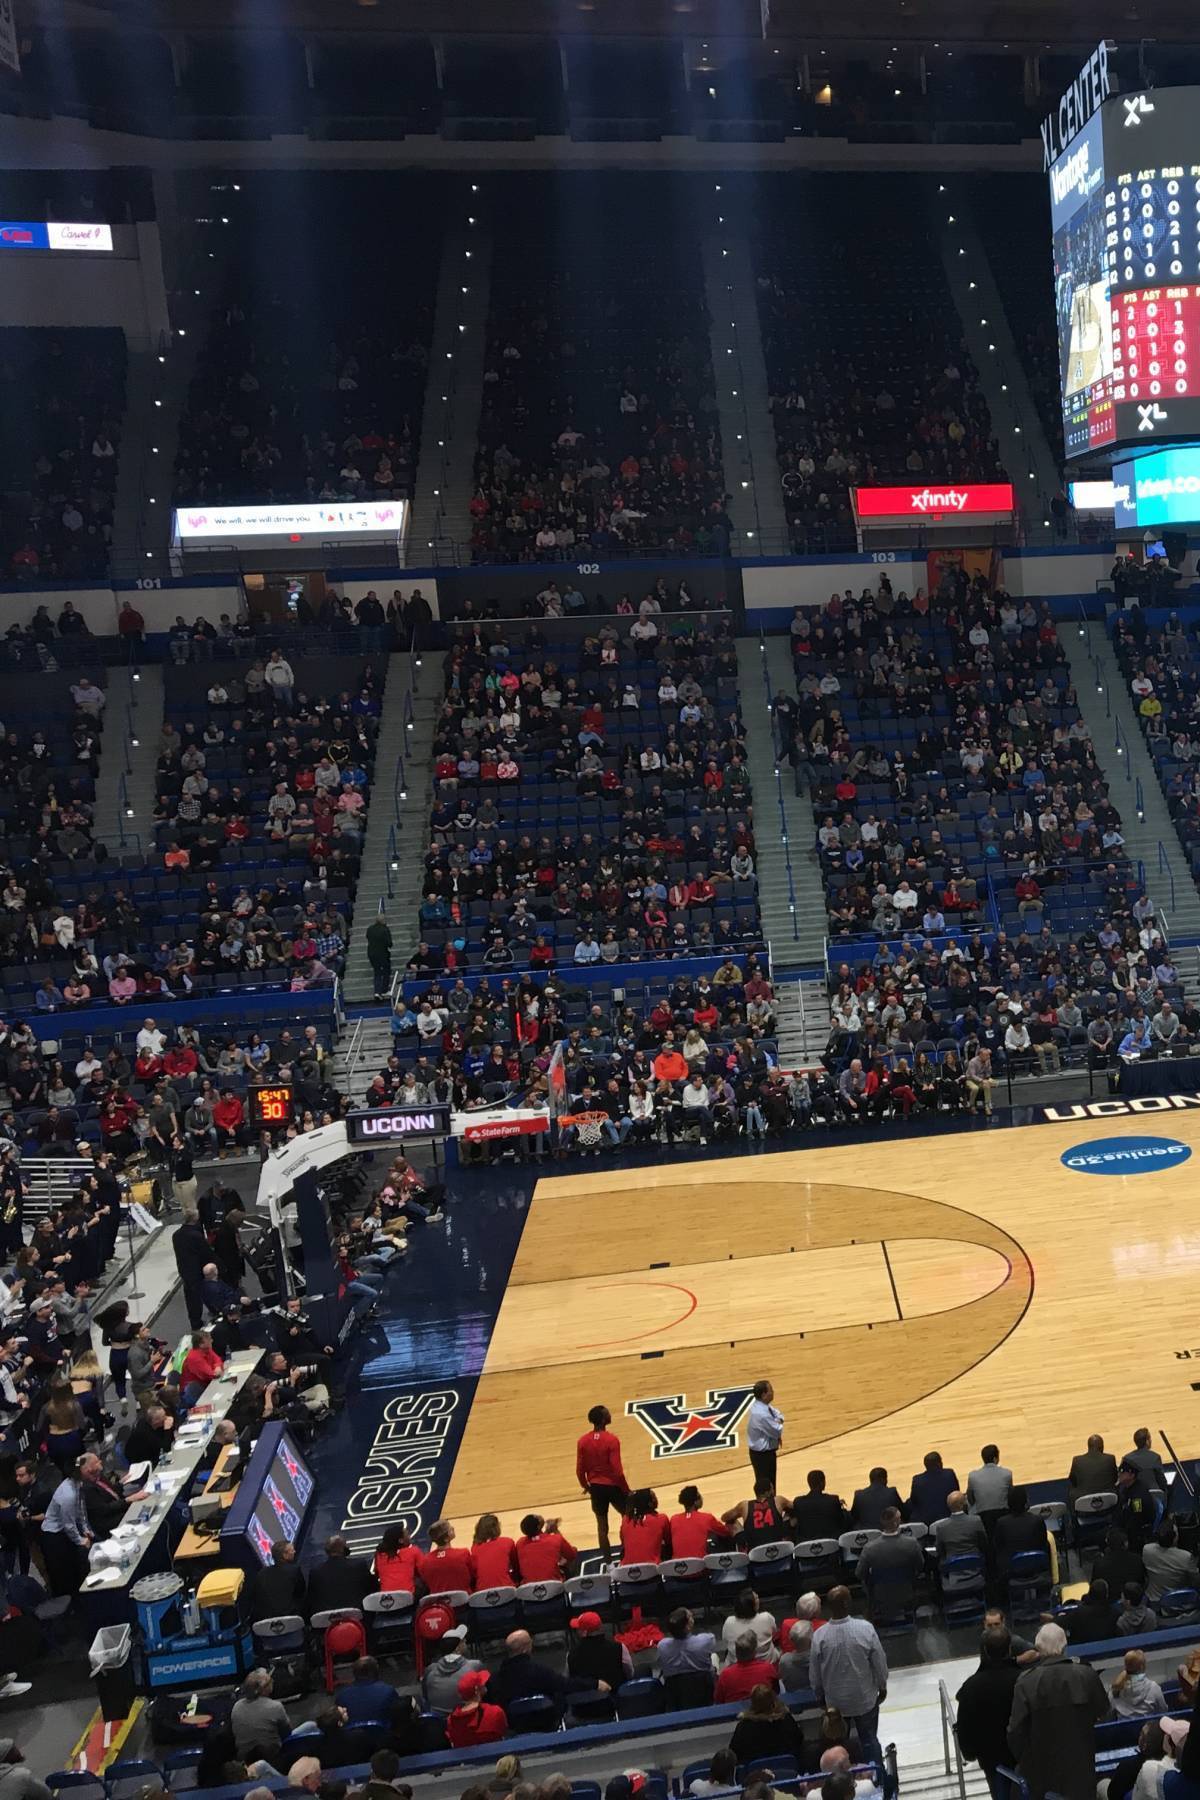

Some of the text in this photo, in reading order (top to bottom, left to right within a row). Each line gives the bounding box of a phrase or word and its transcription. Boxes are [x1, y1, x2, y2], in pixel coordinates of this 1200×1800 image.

[1040, 113, 1057, 173] XL
[1059, 40, 1110, 149] CENTER
[1123, 95, 1155, 127] XL
[1051, 140, 1089, 205] Vantage
[1137, 170, 1156, 181] AST
[1167, 180, 1179, 195] 0
[1143, 290, 1160, 301] AST
[1173, 340, 1185, 354] 0
[1129, 363, 1138, 378] 0
[1149, 361, 1160, 376] 0
[1174, 359, 1186, 374] 0
[1130, 383, 1139, 397] 0
[1150, 380, 1161, 395] 0
[1175, 378, 1187, 393] 0
[1137, 402, 1168, 432] XL
[911, 489, 969, 511] xfinity
[872, 552, 896, 563] 103
[577, 563, 600, 574] 102
[136, 578, 161, 589] 101
[257, 1089, 289, 1102] 15:47
[262, 1103, 282, 1119] 30
[362, 1114, 435, 1135] UCONN
[1067, 1144, 1190, 1167] genius3D
[341, 1390, 459, 1545] USKIES
[753, 1508, 774, 1529] 24
[152, 1656, 232, 1676] POWERADE
